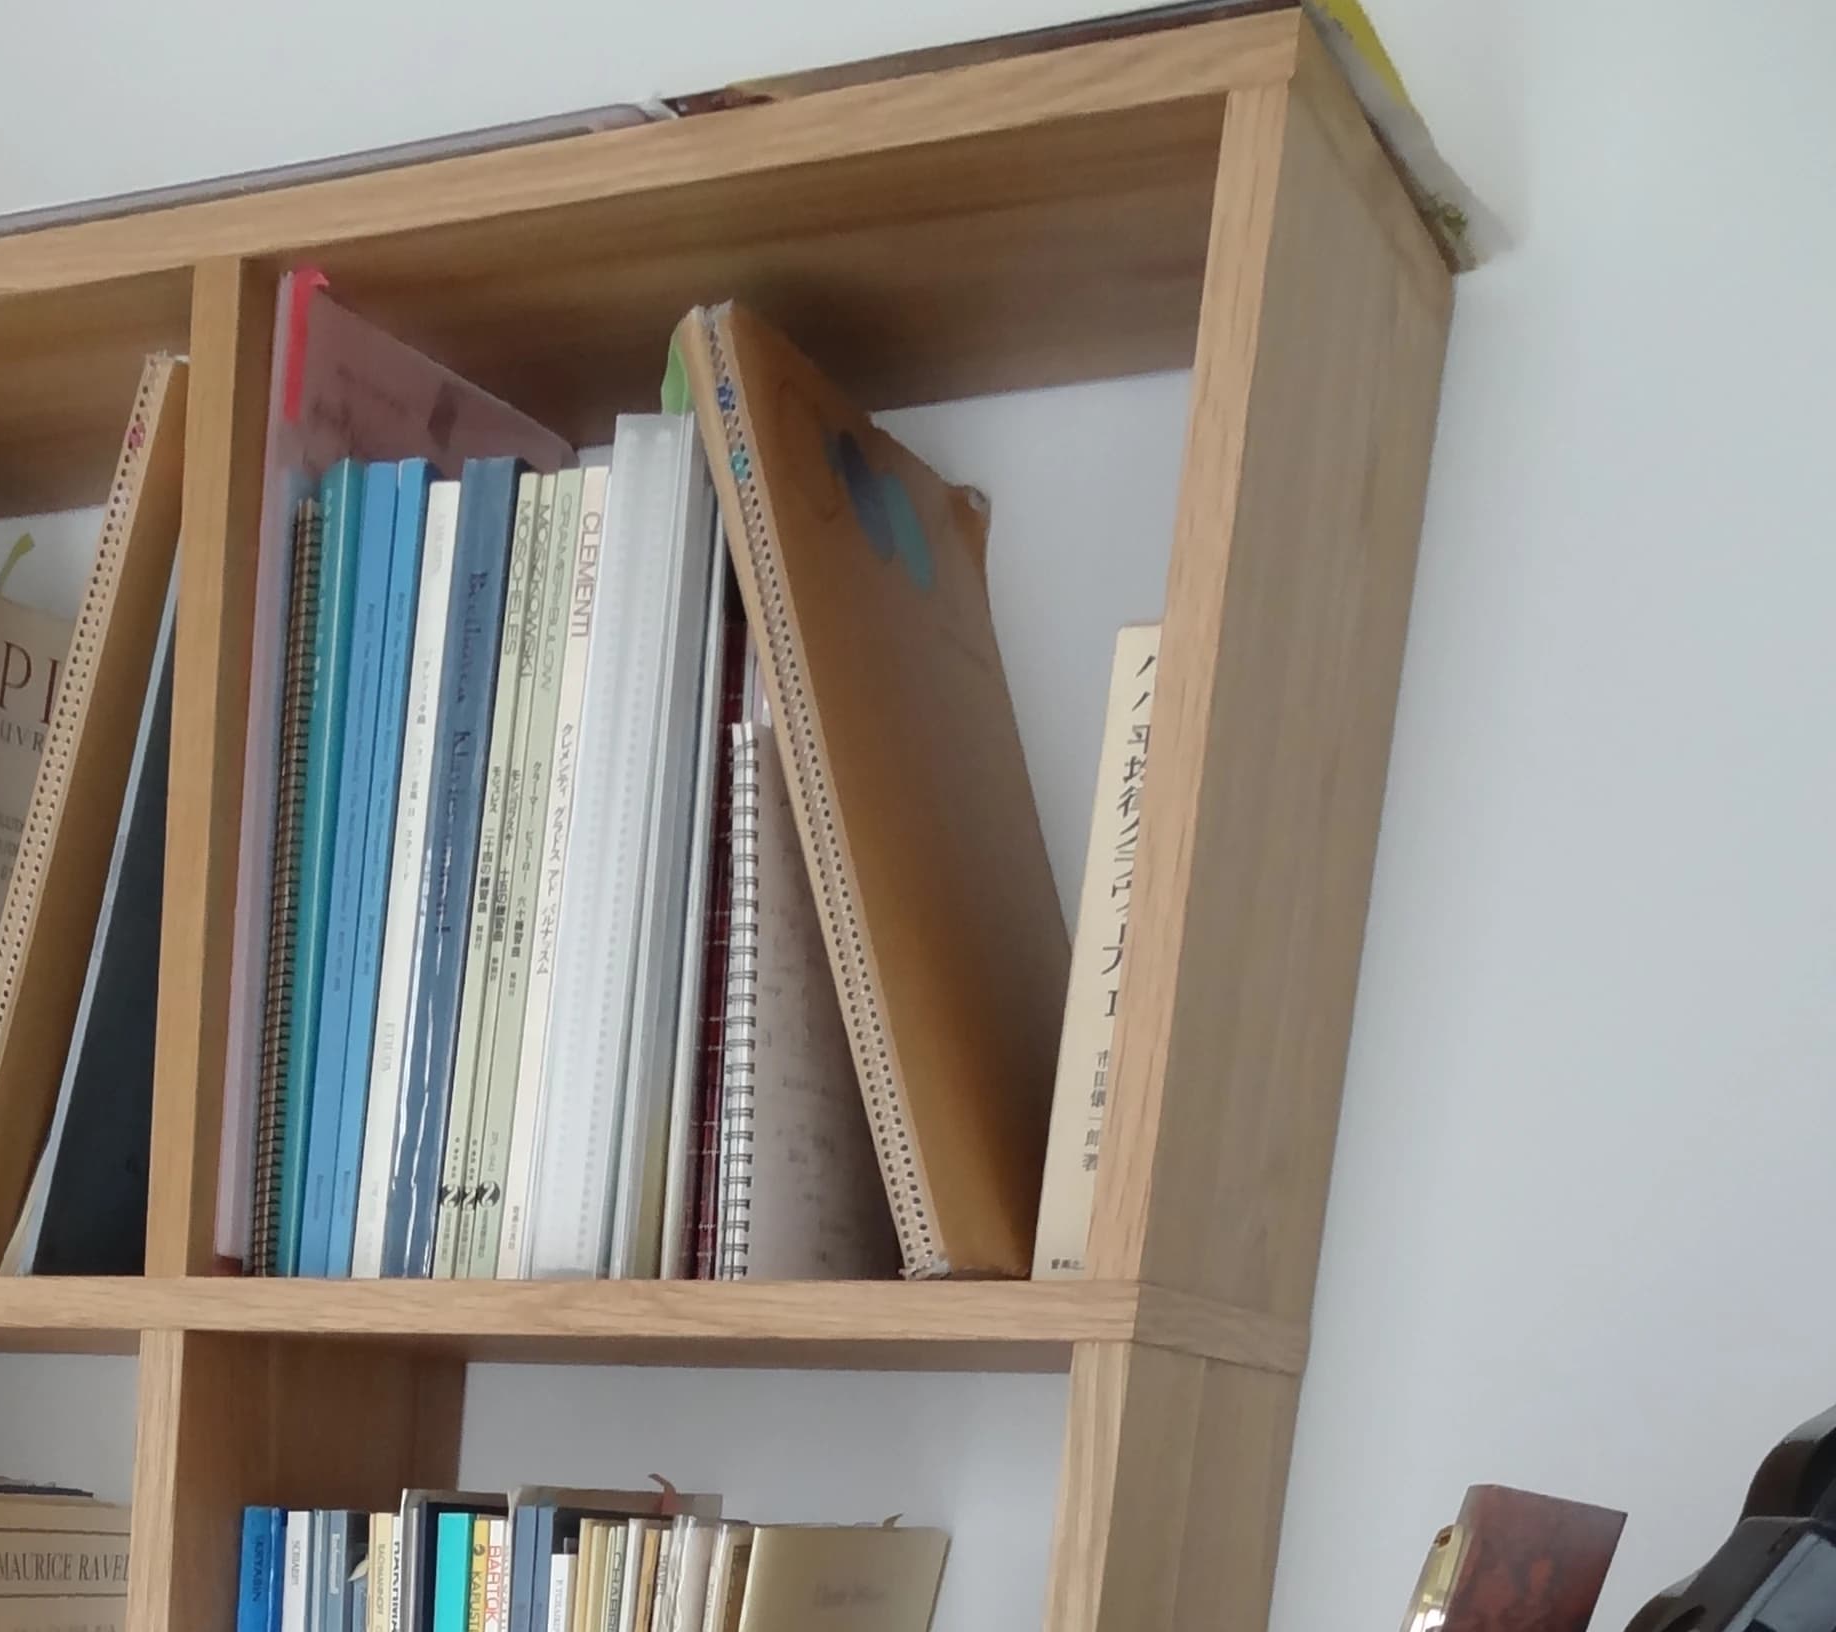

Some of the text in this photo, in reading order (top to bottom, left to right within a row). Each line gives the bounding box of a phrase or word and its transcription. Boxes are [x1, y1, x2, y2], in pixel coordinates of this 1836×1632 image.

[504, 500, 531, 656] MOSCHELES
[521, 503, 550, 677] MOSZKOWSKI
[572, 511, 600, 638] CLEMENTI
[556, 723, 573, 796] クレメンティ
[551, 806, 566, 861] グラドス
[547, 869, 560, 896] アド
[78, 1552, 130, 1581] RAVEL
